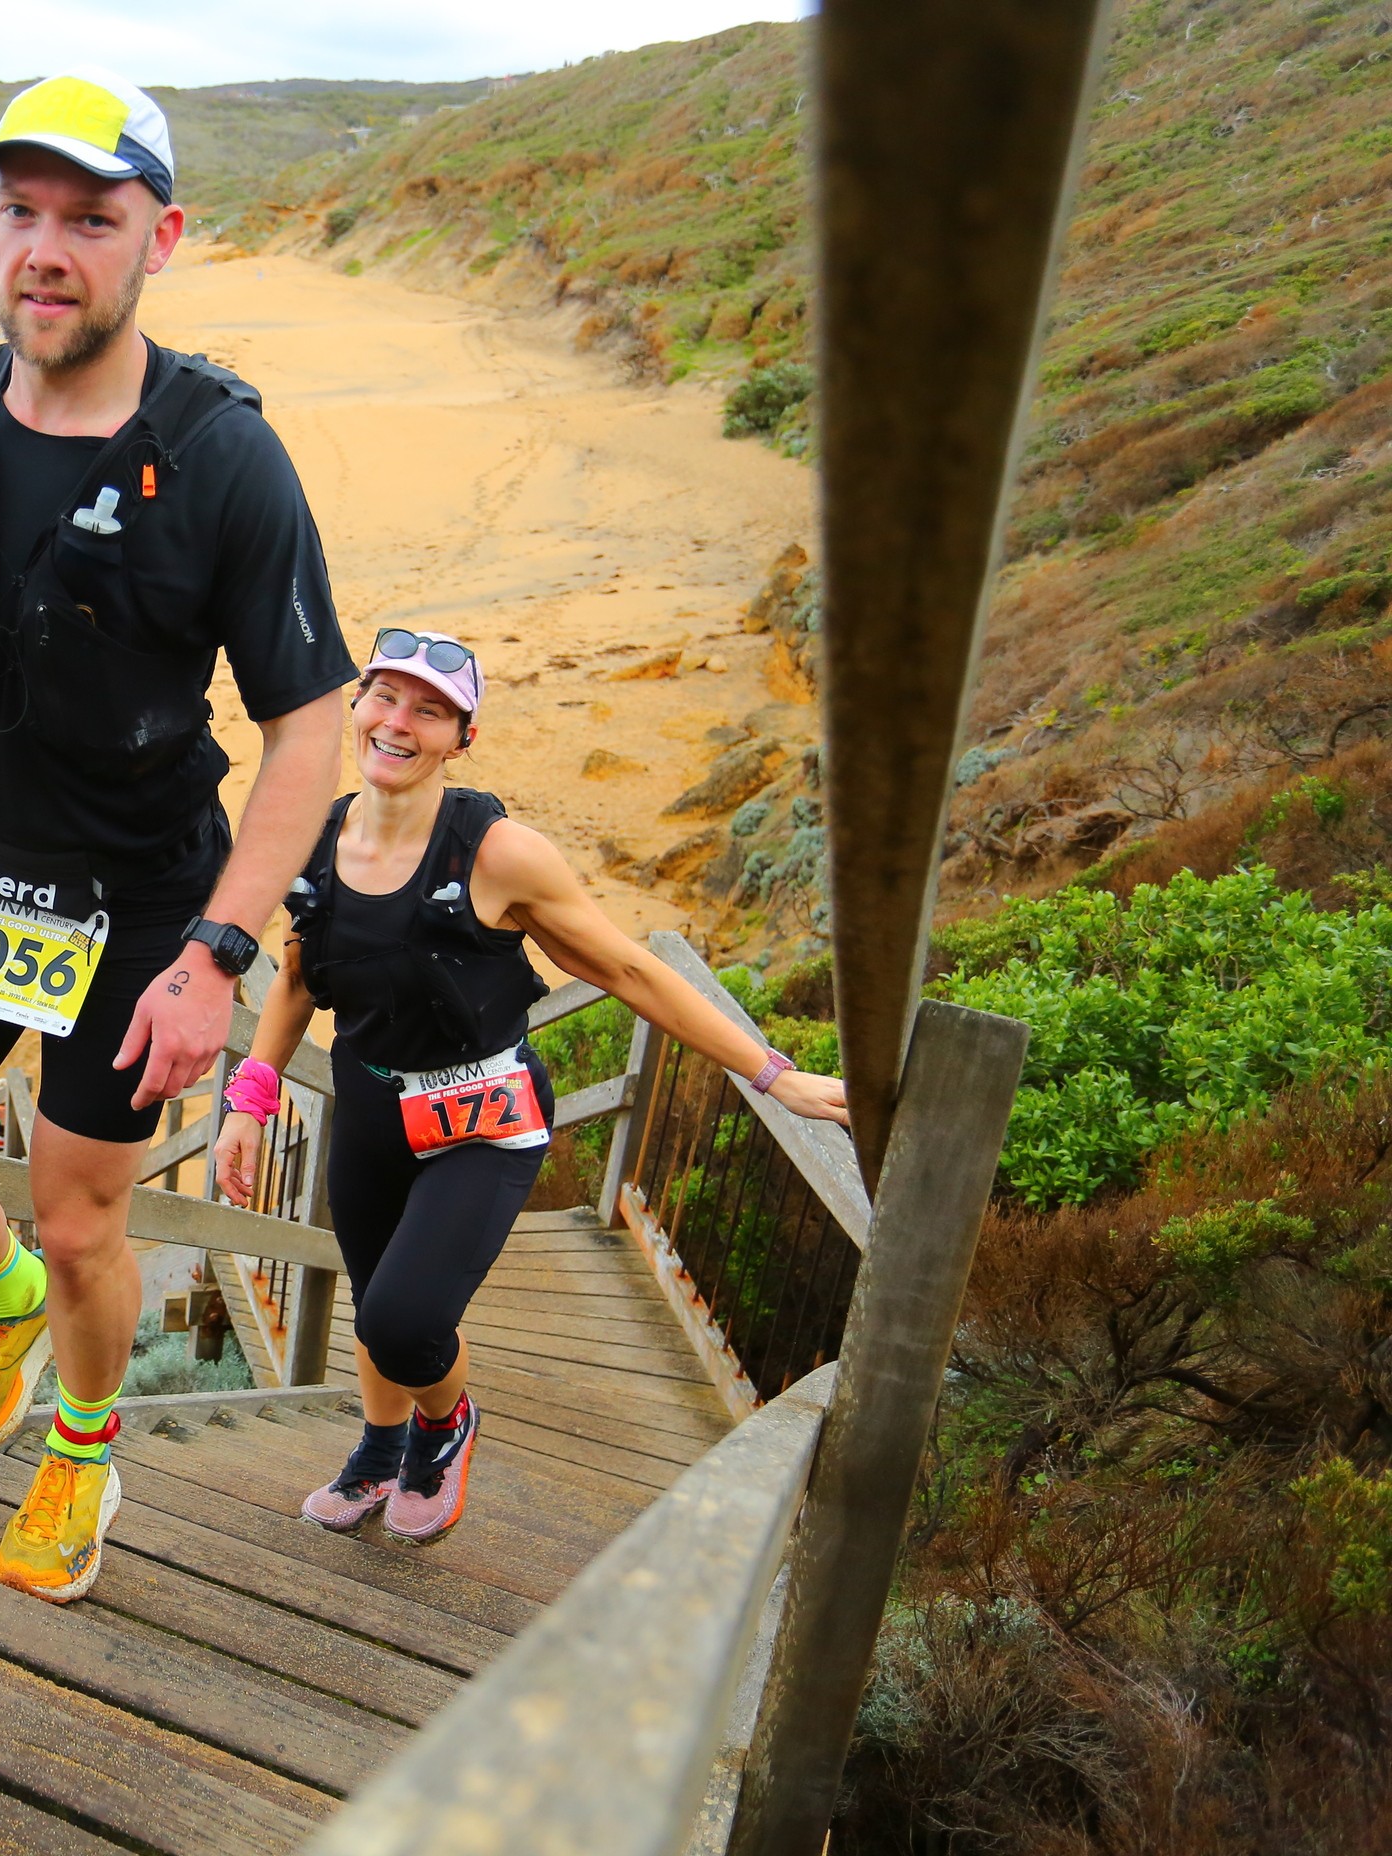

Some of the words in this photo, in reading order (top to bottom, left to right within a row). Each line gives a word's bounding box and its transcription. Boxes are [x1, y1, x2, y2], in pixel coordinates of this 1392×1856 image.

[7, 920, 36, 934] GOOD
[39, 929, 69, 944] ULTRA
[40, 914, 74, 930] CENTURY
[486, 1060, 504, 1069] COAST
[487, 1065, 511, 1076] CENTURY
[419, 1062, 485, 1092] 100KM
[428, 1091, 441, 1101] THE
[443, 1087, 460, 1097] FEEL
[460, 1082, 483, 1093] GOOD
[431, 1087, 522, 1138] 172
[66, 1537, 97, 1582] HOKA
